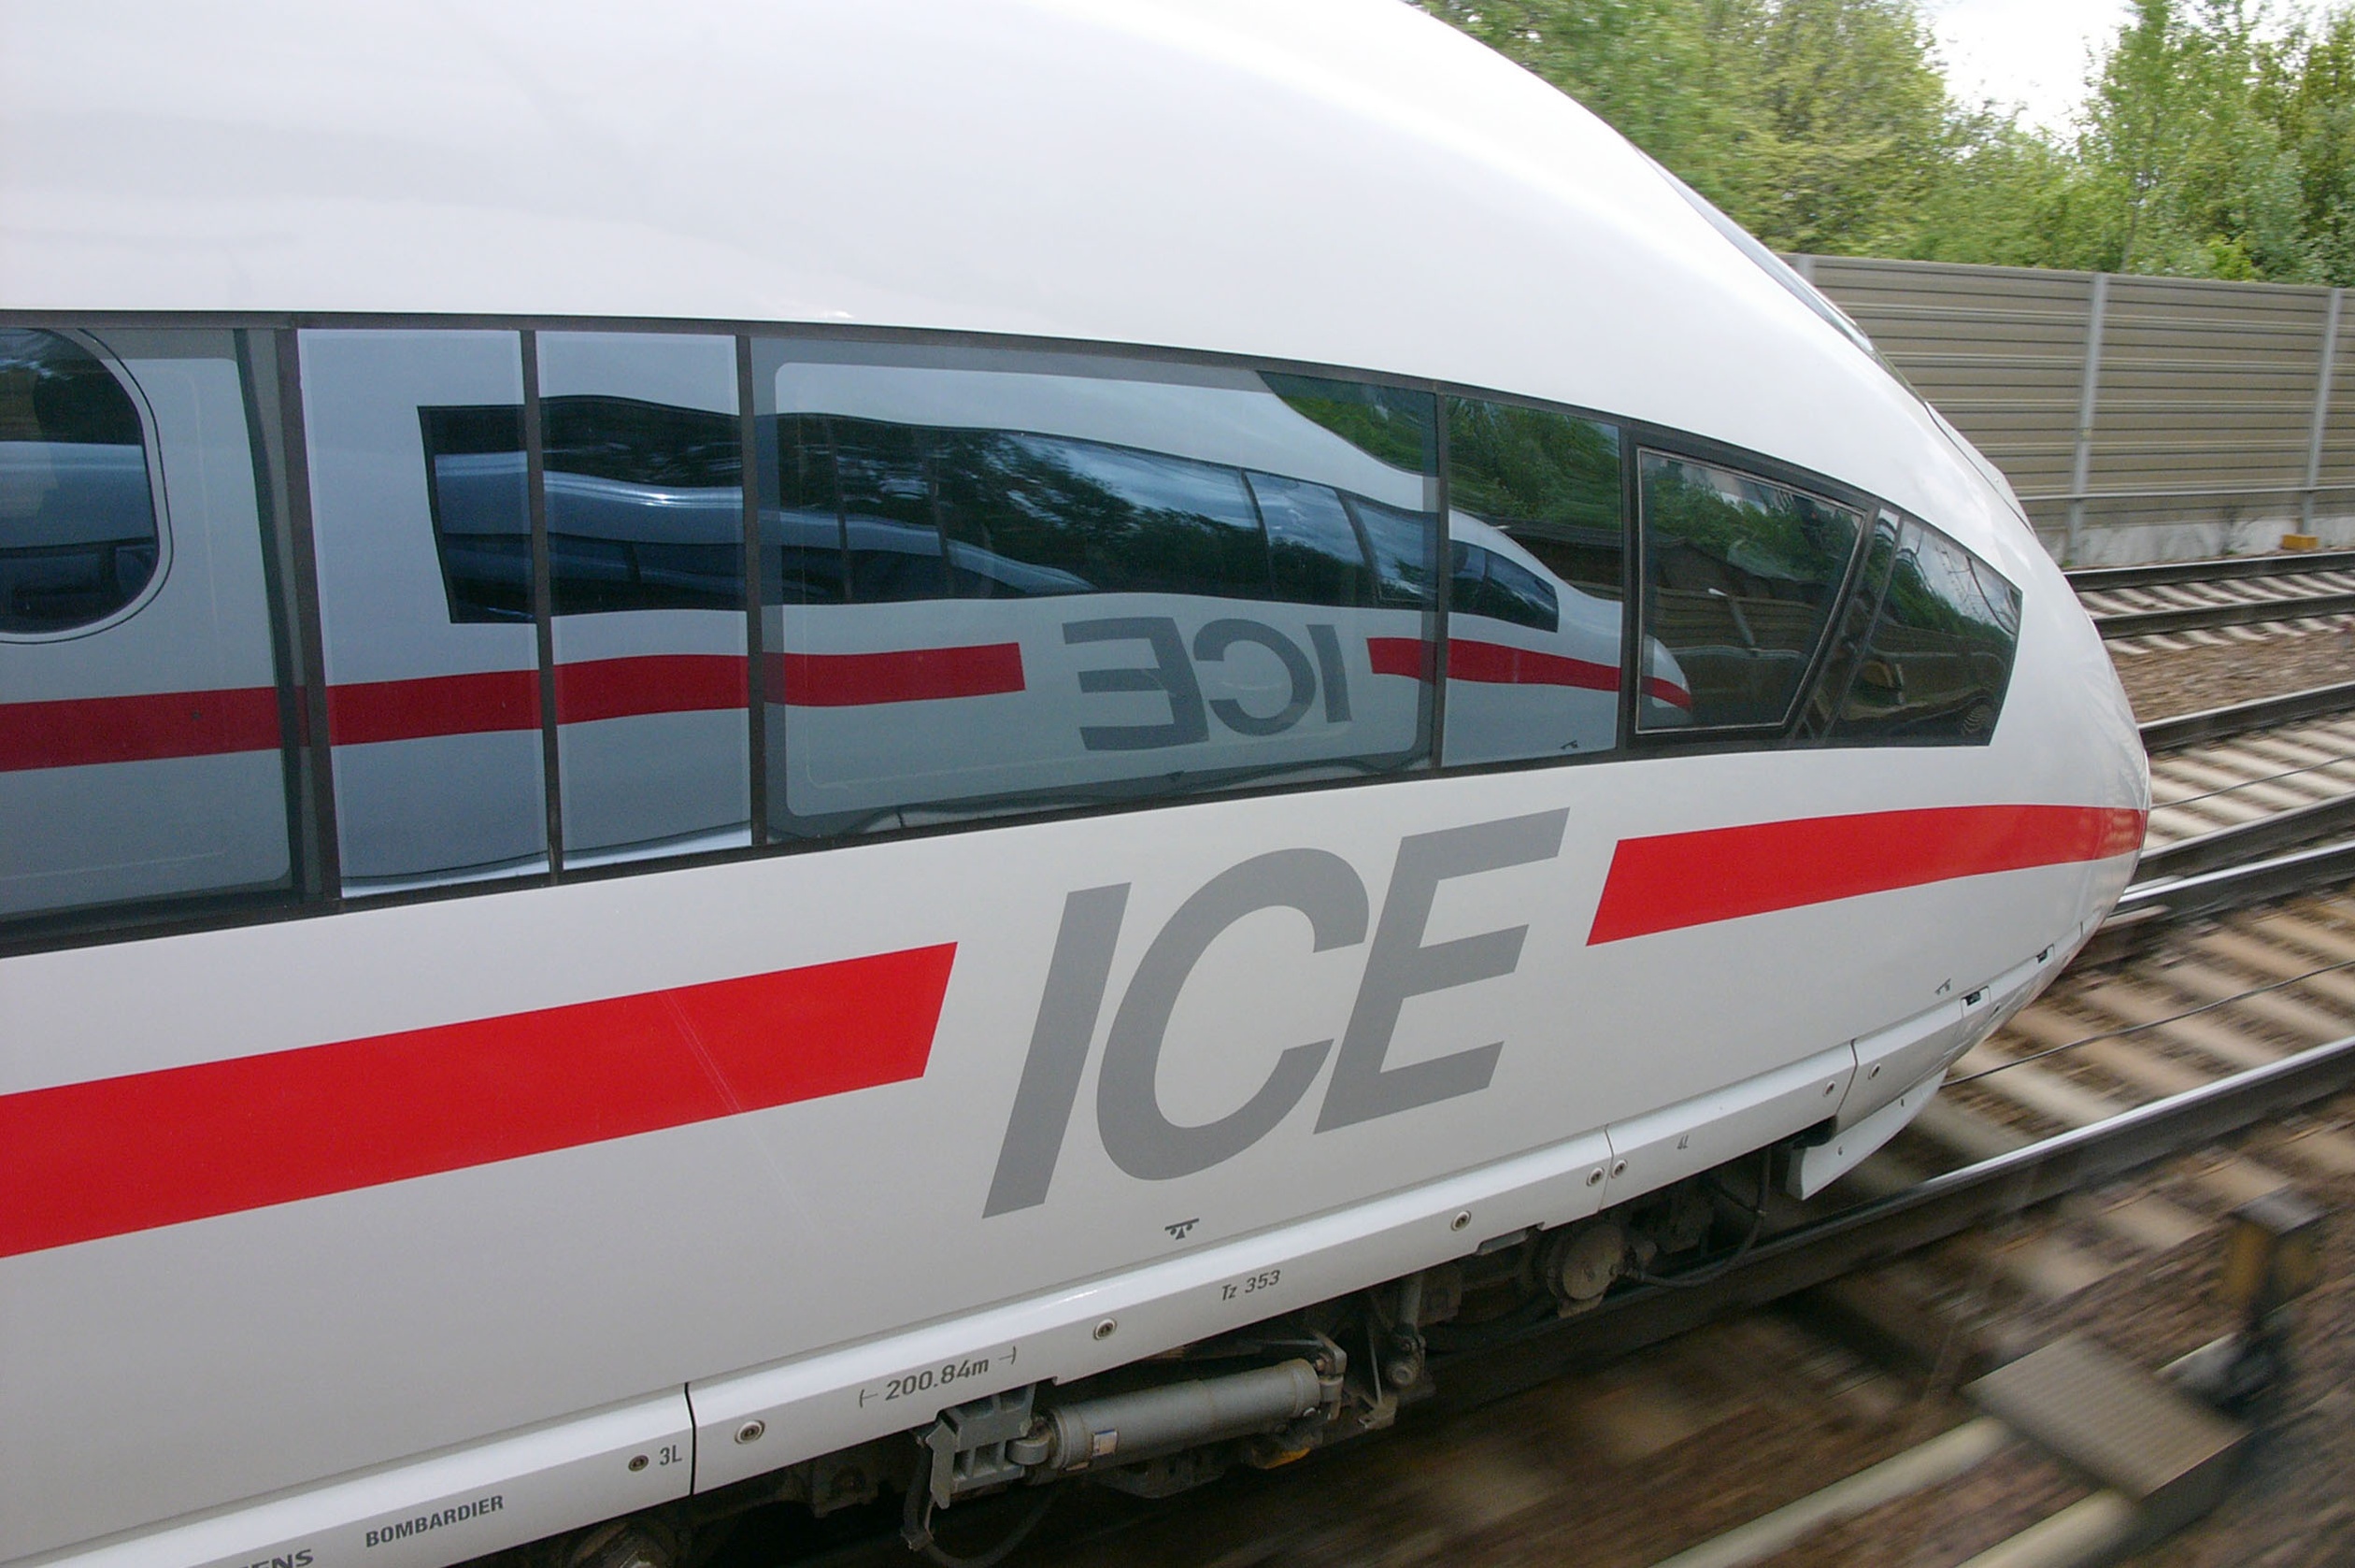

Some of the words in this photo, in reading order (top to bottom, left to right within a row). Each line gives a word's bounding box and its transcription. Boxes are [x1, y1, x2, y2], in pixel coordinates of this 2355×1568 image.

[982, 806, 1571, 1219] ICE
[1221, 1283, 1237, 1301] Tz
[1245, 1269, 1281, 1293] 353
[886, 1358, 990, 1401] 200.84m
[660, 1444, 683, 1466] 3L
[365, 1495, 504, 1547] BOMBARDIER
